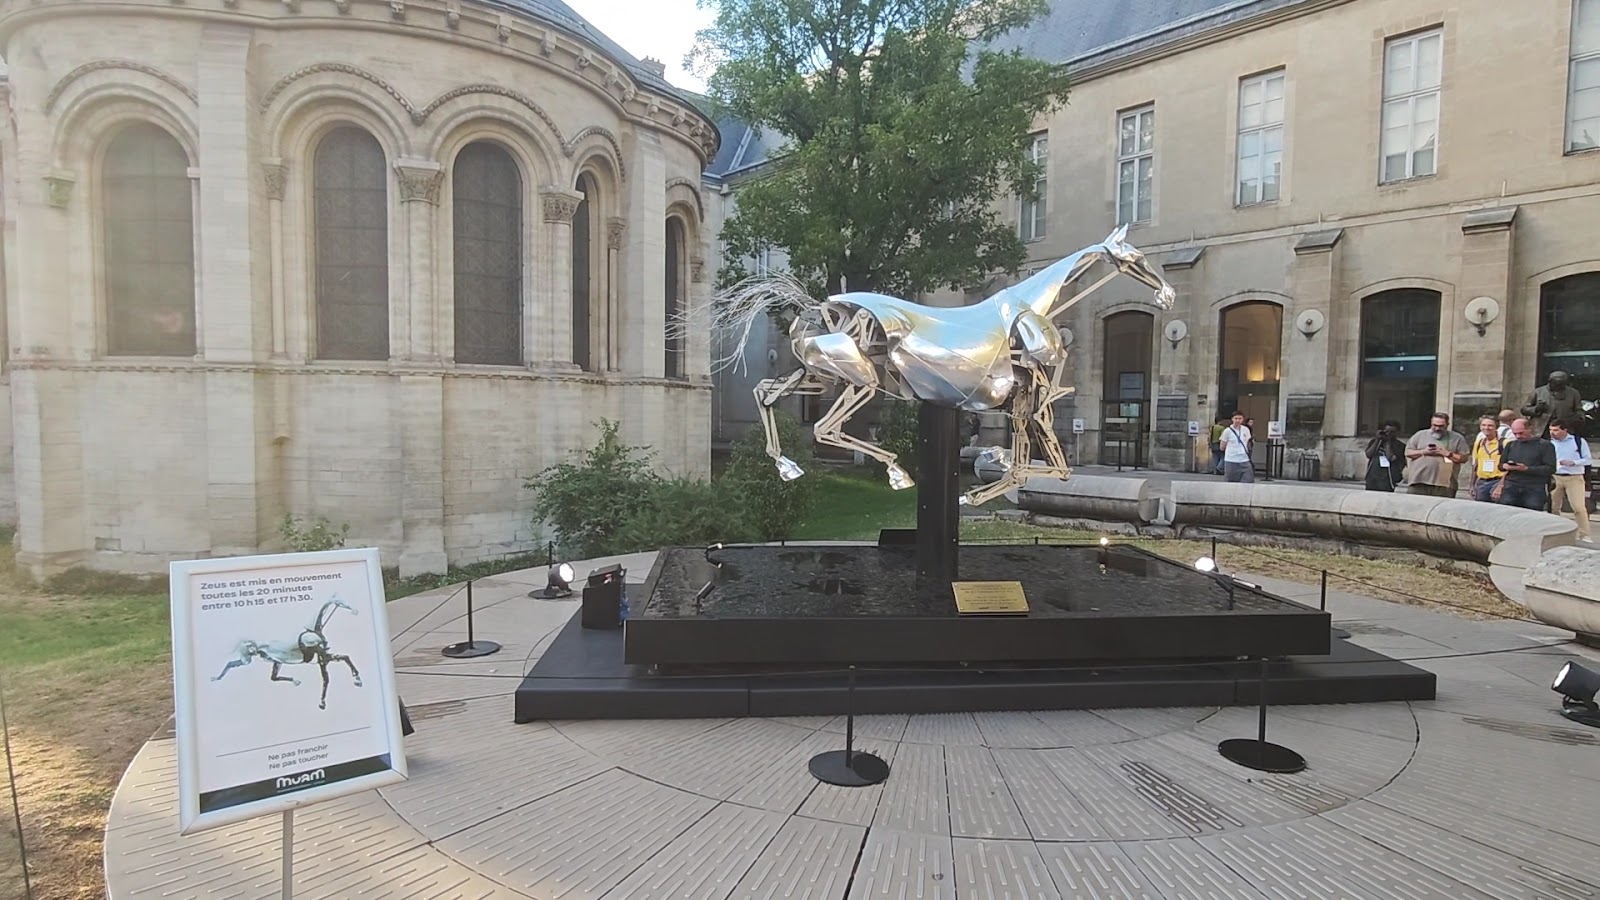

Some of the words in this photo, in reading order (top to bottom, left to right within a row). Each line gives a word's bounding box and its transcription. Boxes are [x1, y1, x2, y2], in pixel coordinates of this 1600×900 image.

[200, 581, 227, 590] Zeus
[229, 580, 246, 588] est
[248, 578, 267, 586] mis
[284, 573, 343, 583] mouvement
[201, 591, 237, 600] toutes
[239, 589, 255, 597] les
[256, 588, 270, 596] 20
[272, 584, 313, 595] minutes
[201, 602, 232, 611] entre
[267, 597, 278, 605] et
[281, 751, 296, 759] pas
[297, 744, 329, 755] franchir
[282, 760, 297, 768] pas
[298, 753, 329, 764] toucher
